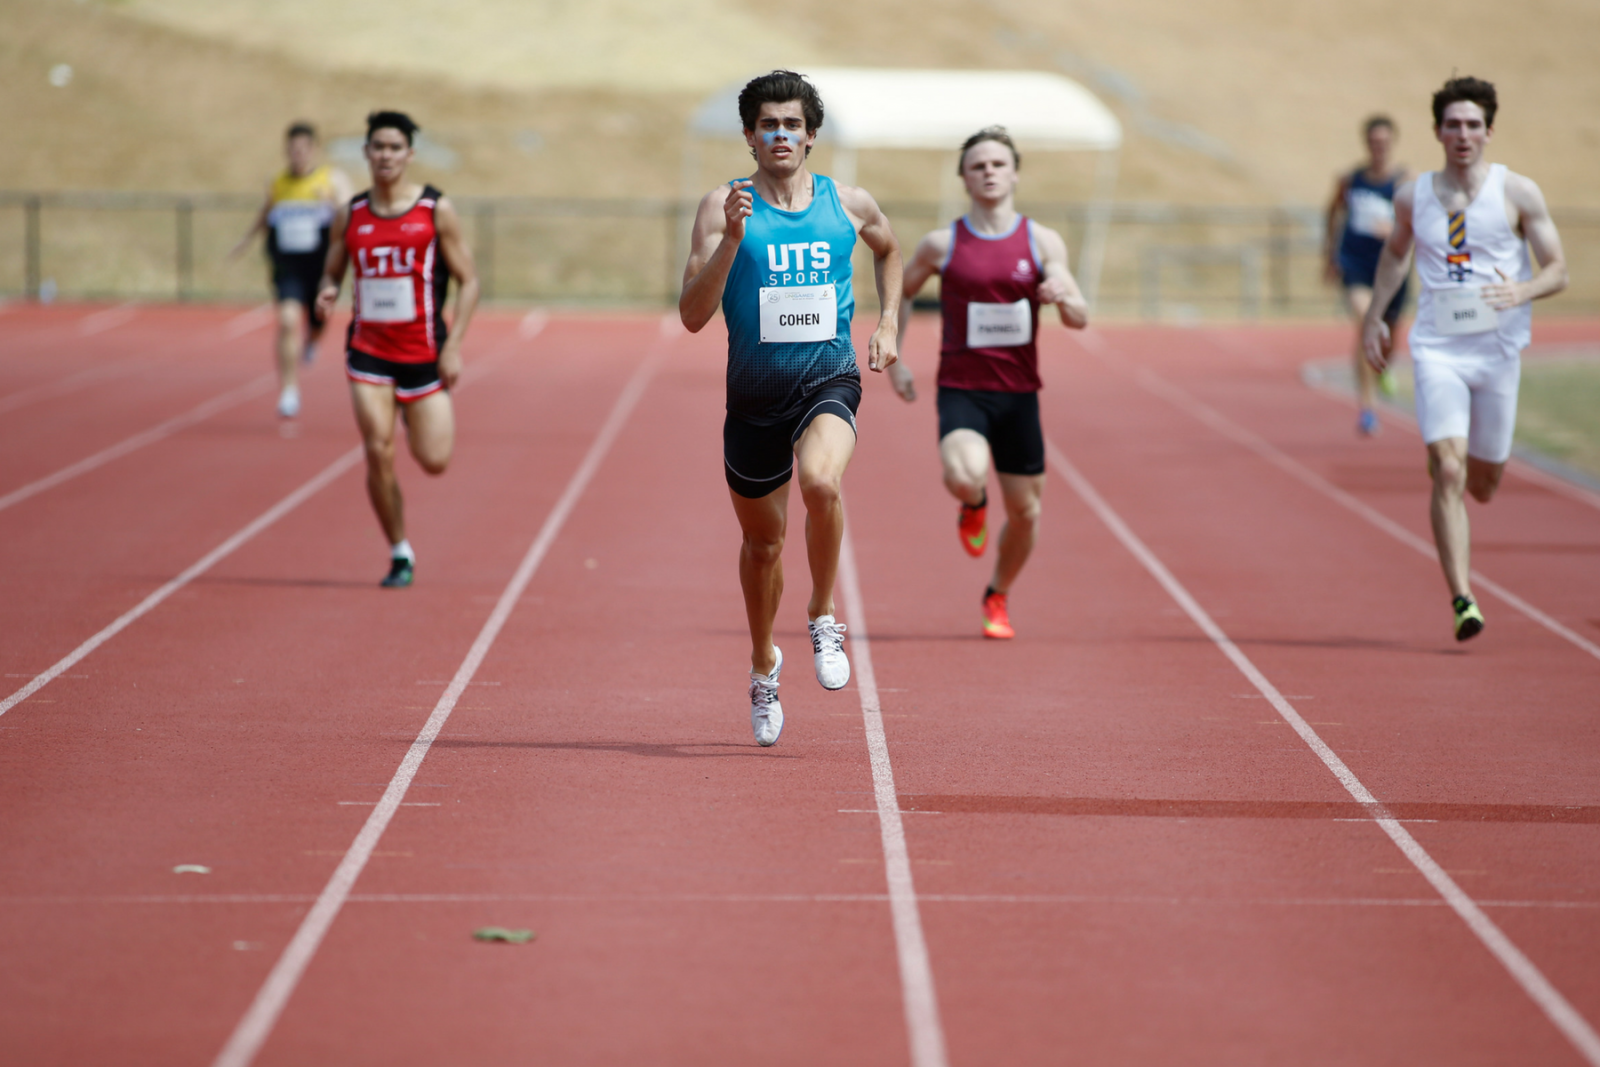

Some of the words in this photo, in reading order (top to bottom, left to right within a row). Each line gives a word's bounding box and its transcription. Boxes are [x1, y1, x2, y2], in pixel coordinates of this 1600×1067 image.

[358, 246, 416, 277] LTU
[767, 241, 831, 272] UTS
[769, 271, 830, 286] SPORT
[779, 313, 820, 326] COHEN
